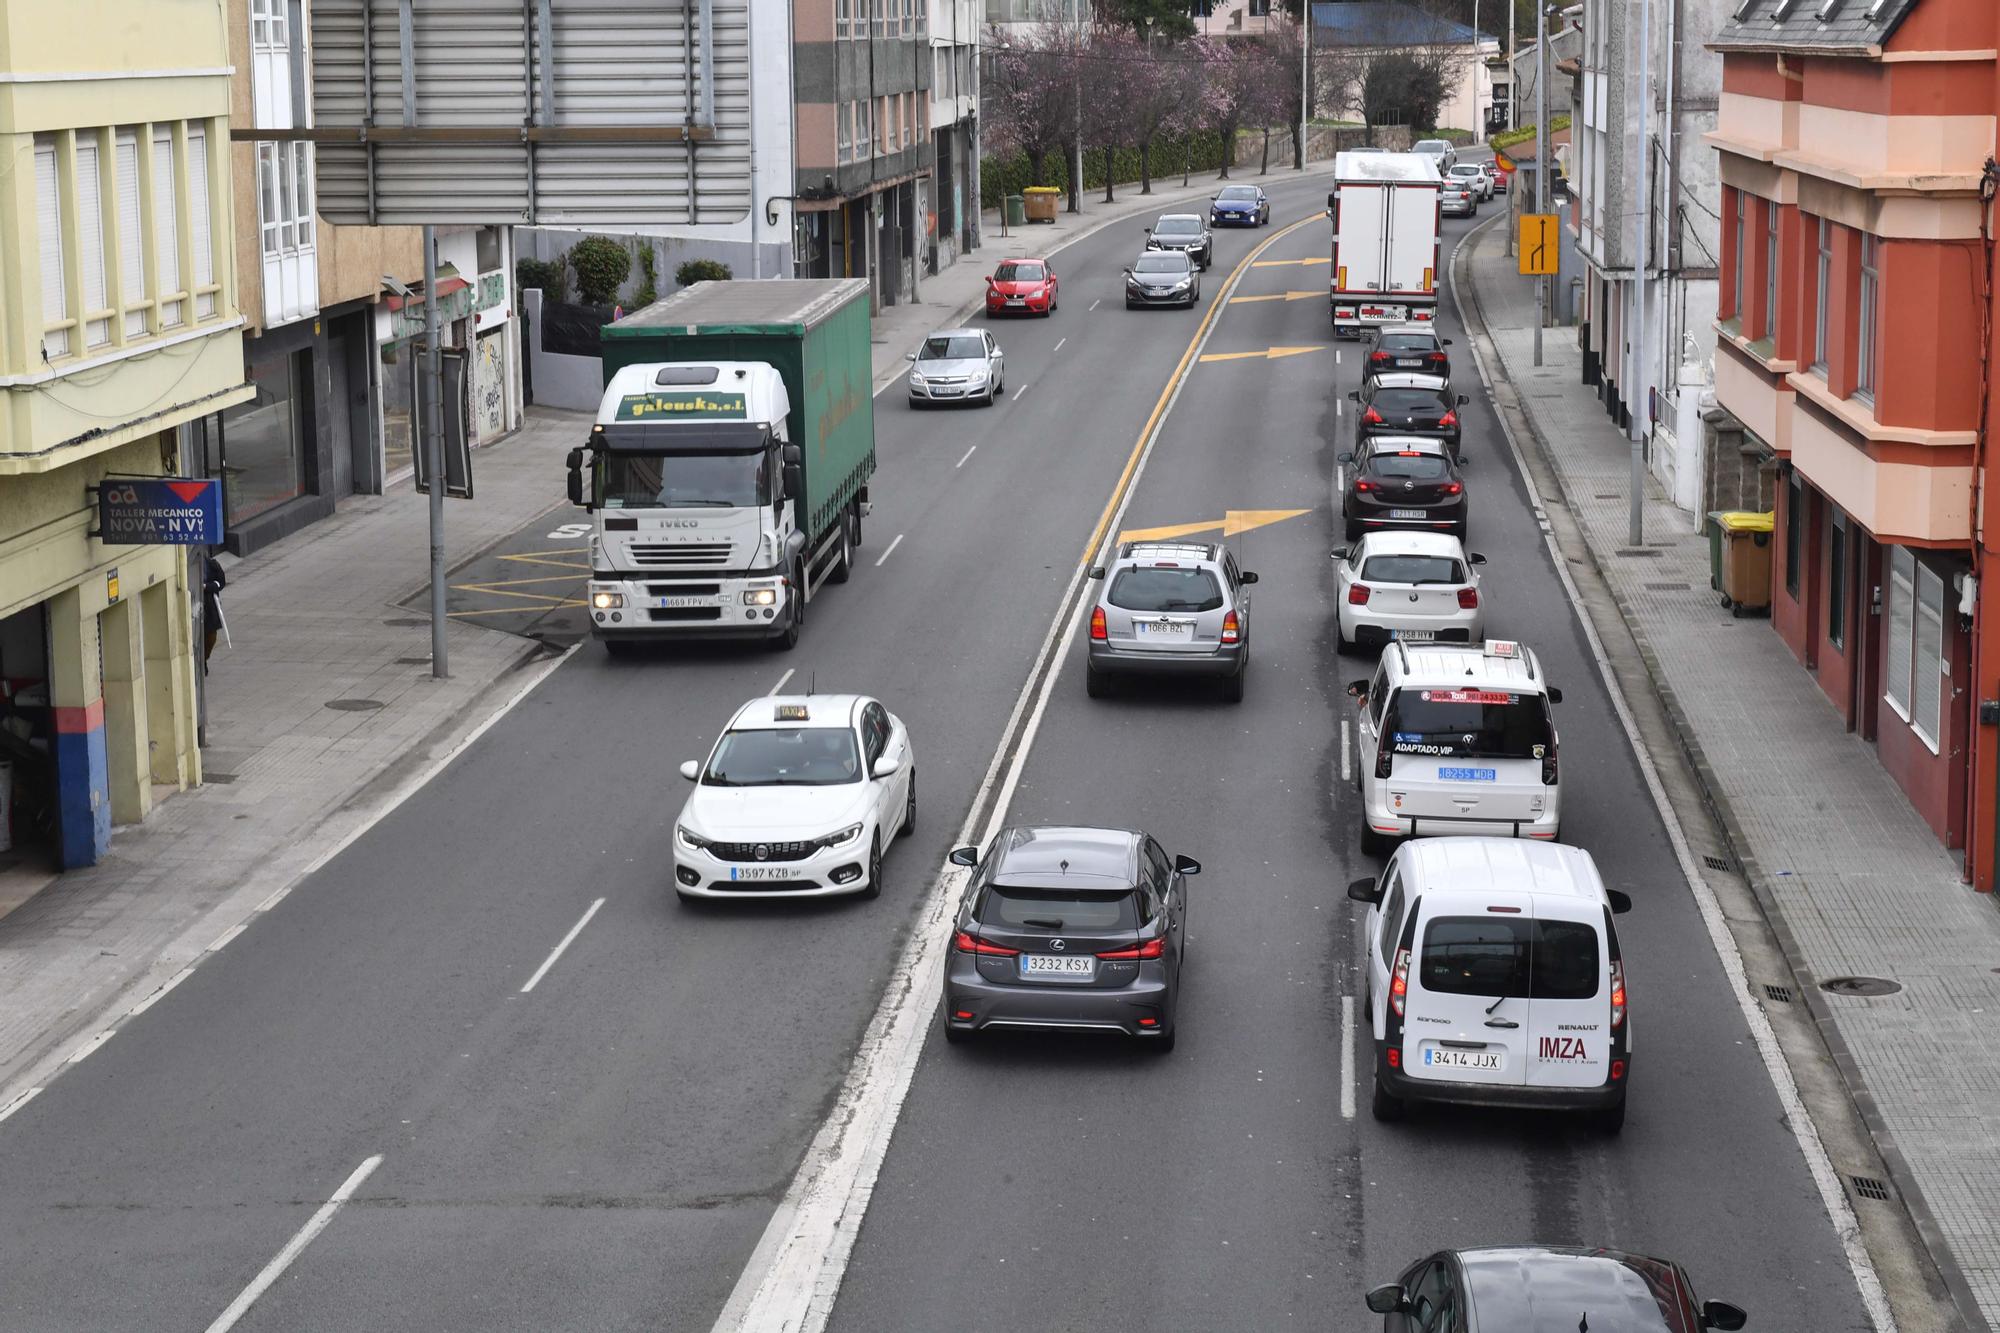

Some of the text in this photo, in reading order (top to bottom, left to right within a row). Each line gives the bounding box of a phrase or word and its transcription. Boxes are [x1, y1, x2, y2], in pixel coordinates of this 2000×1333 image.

[110, 508, 203, 518] TALLER MECANICO
[110, 519, 155, 532] NOVA
[659, 519, 698, 528] IVECO
[178, 533, 189, 541] 52
[193, 533, 204, 541] 44
[781, 706, 798, 717] TAXI
[1394, 743, 1453, 755] ADAPTADO VIP
[739, 868, 765, 878] 3597
[768, 867, 788, 878] KZB
[1031, 957, 1090, 971] 3232 KSX
[1539, 1037, 1586, 1059] IMZA
[1434, 1052, 1498, 1068] 3414 JJX
